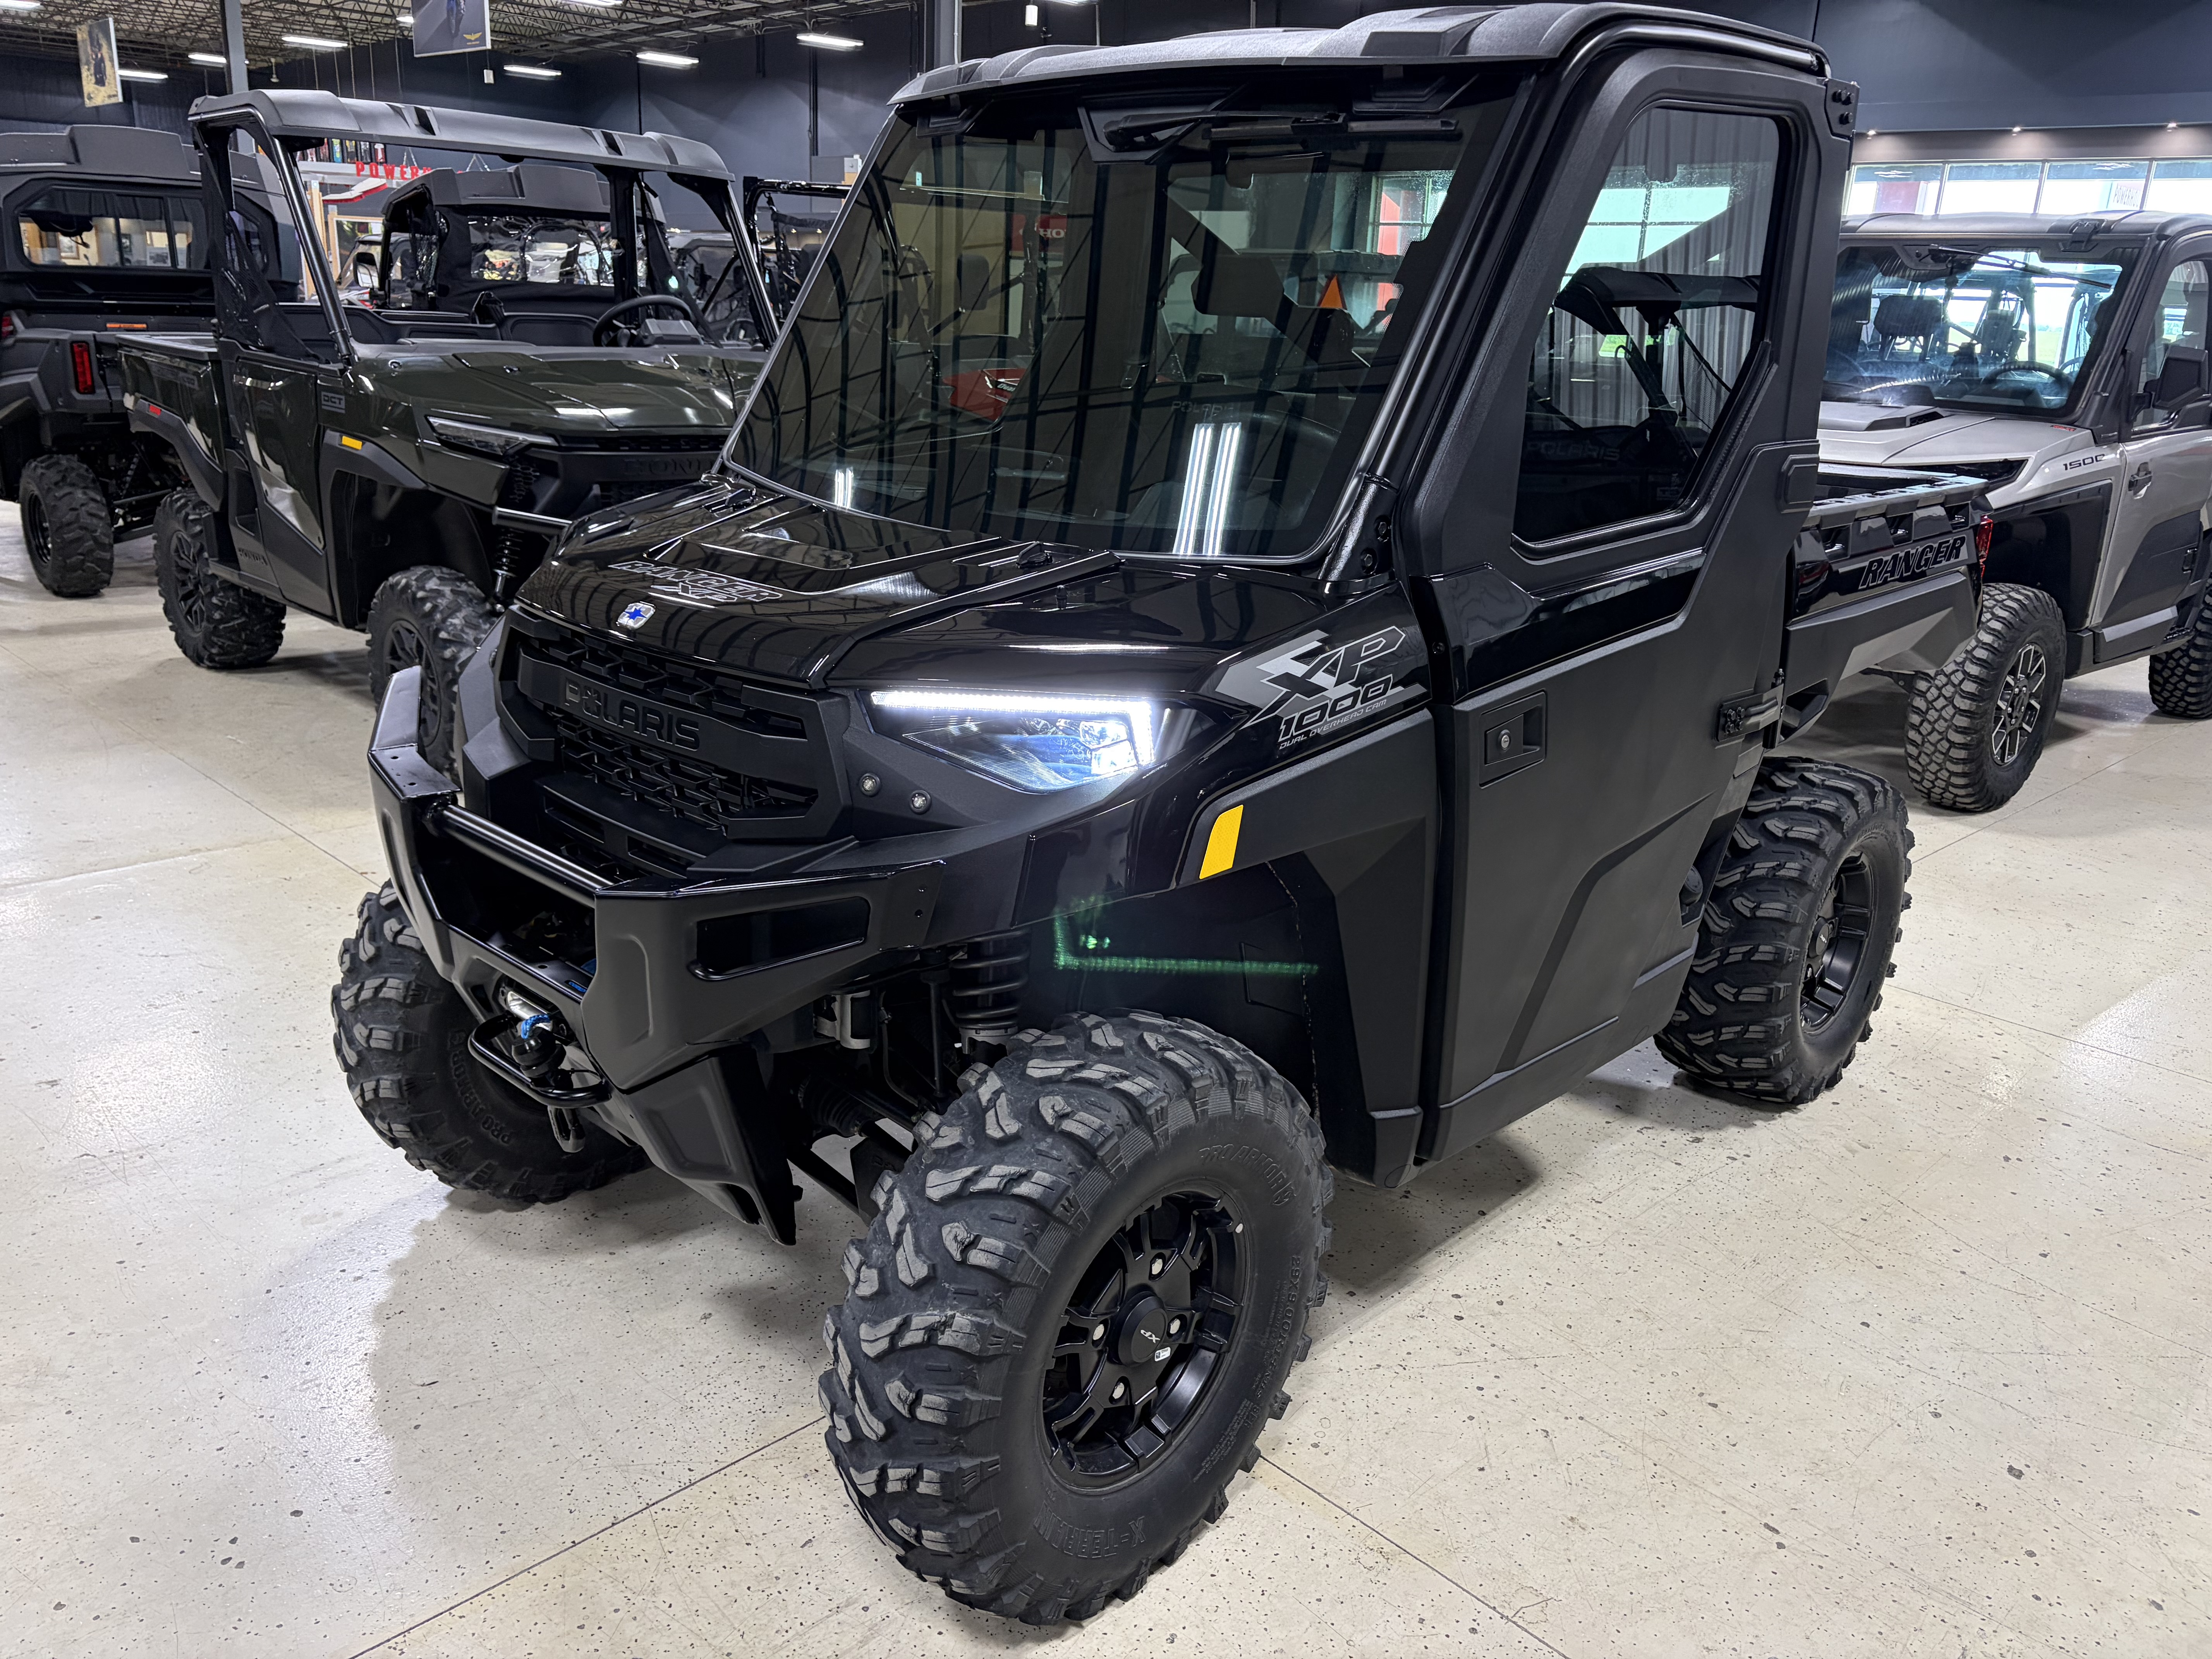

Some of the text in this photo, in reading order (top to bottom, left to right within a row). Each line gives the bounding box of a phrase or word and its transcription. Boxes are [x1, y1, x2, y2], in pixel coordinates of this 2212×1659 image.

[323, 395, 343, 405] DCT
[622, 458, 716, 475] HOND
[608, 560, 783, 602] RANGER
[1858, 535, 1966, 589] RANGER
[651, 582, 737, 602] XP
[1239, 625, 1406, 730] XP
[564, 680, 700, 752] POLARIS
[1278, 674, 1393, 742] 1000
[1279, 699, 1388, 750] DUAL OVERHEAD CAM
[1198, 1144, 1287, 1190] PRO ARMOR
